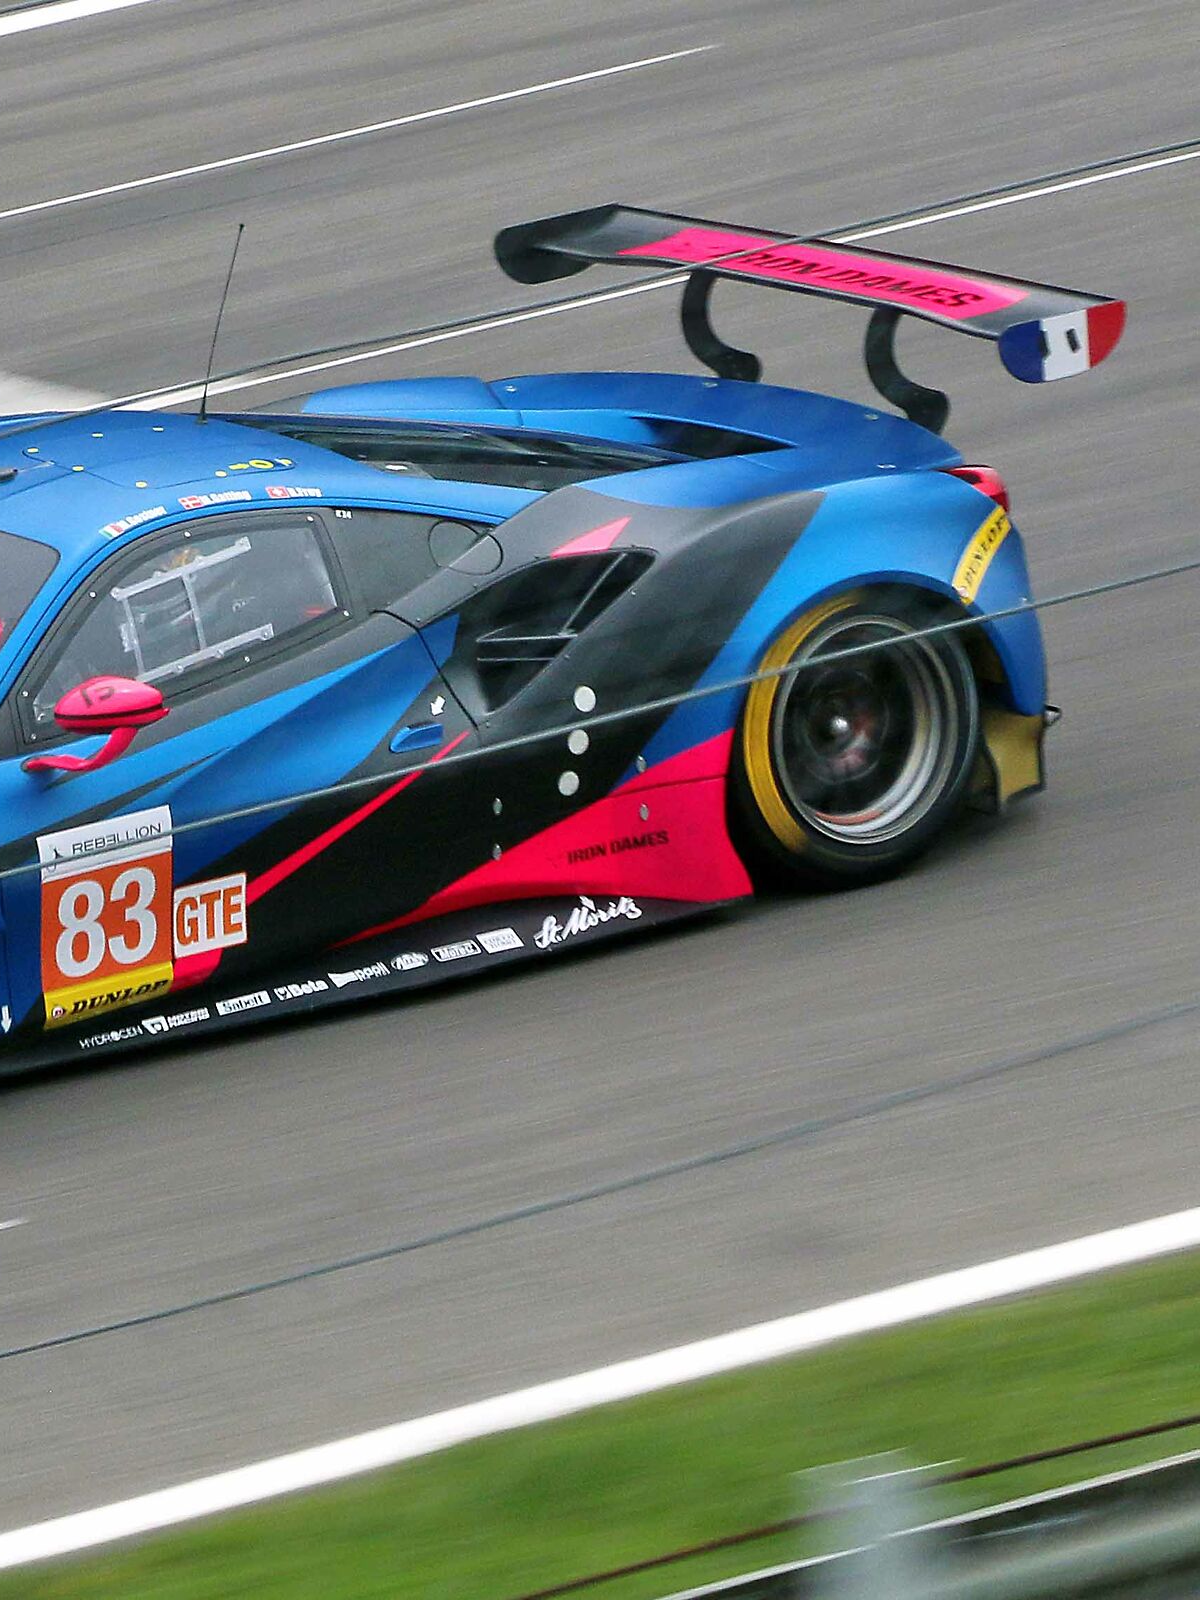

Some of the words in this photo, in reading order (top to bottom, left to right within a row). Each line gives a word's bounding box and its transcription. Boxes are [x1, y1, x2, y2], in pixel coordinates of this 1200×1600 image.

[814, 266, 984, 309] DAMES
[566, 844, 607, 864] IRON
[609, 830, 670, 854] DAMES
[55, 867, 157, 978] 83
[176, 884, 243, 947] GTE
[70, 979, 169, 1015] DUNLOP
